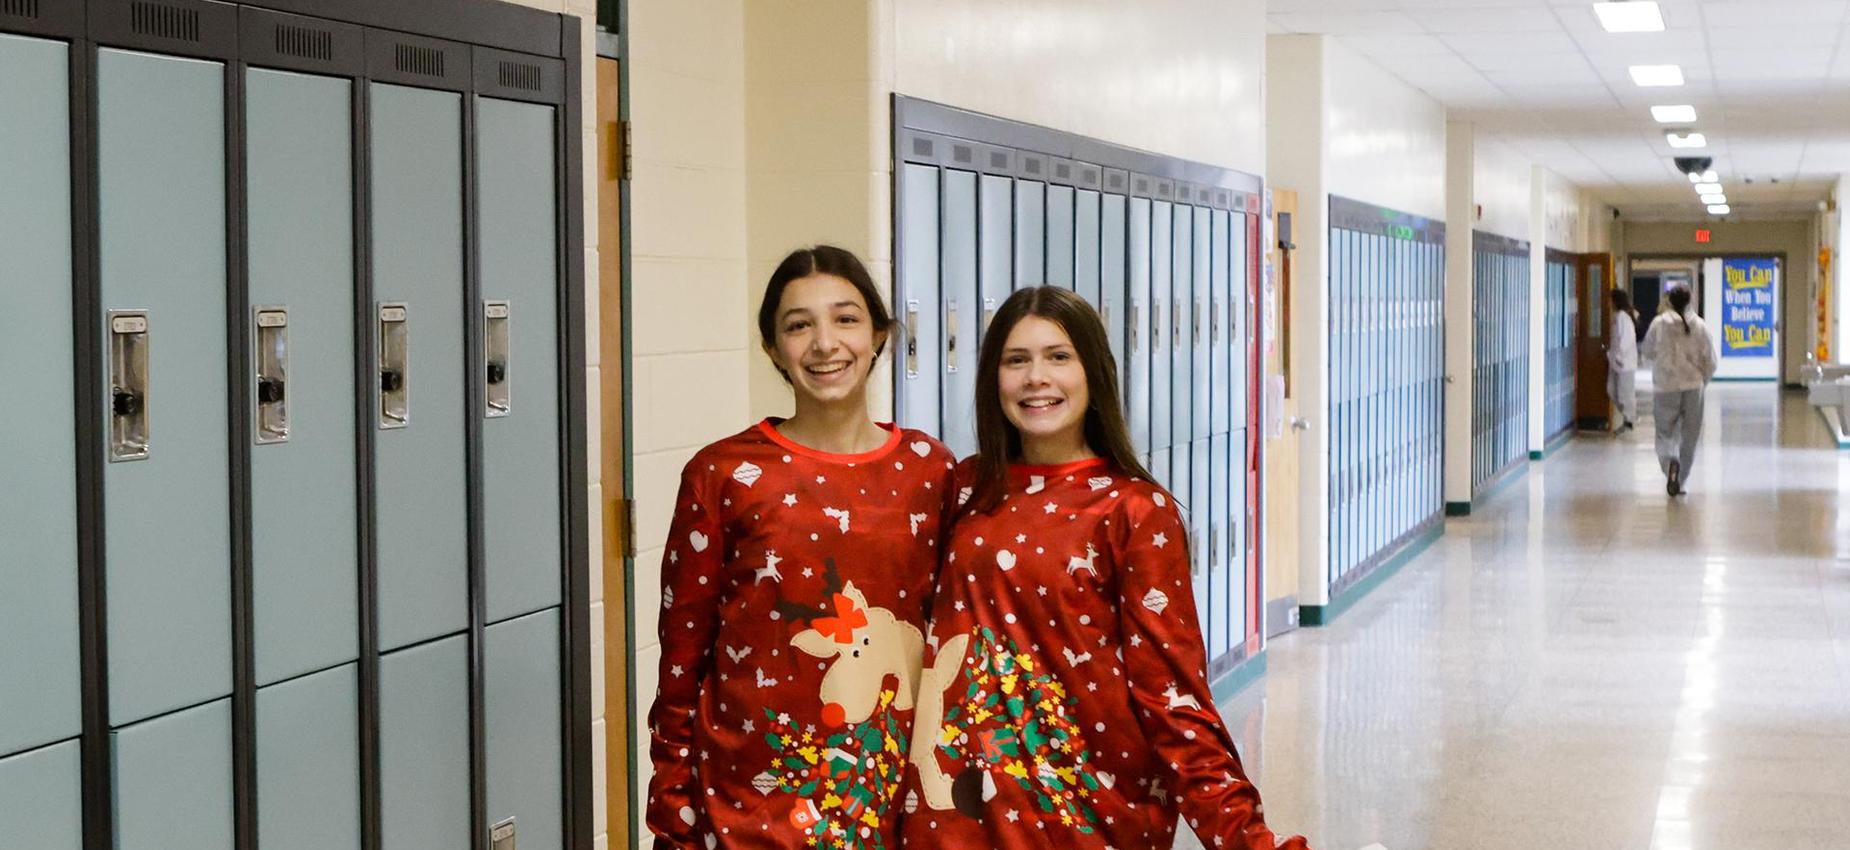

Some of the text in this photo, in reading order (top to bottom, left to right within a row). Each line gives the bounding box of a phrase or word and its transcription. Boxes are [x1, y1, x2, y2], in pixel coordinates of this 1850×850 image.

[1725, 265, 1772, 284] You Can
[1726, 289, 1771, 304] When You
[1731, 306, 1764, 321] Believe
[1724, 324, 1770, 343] You Can
